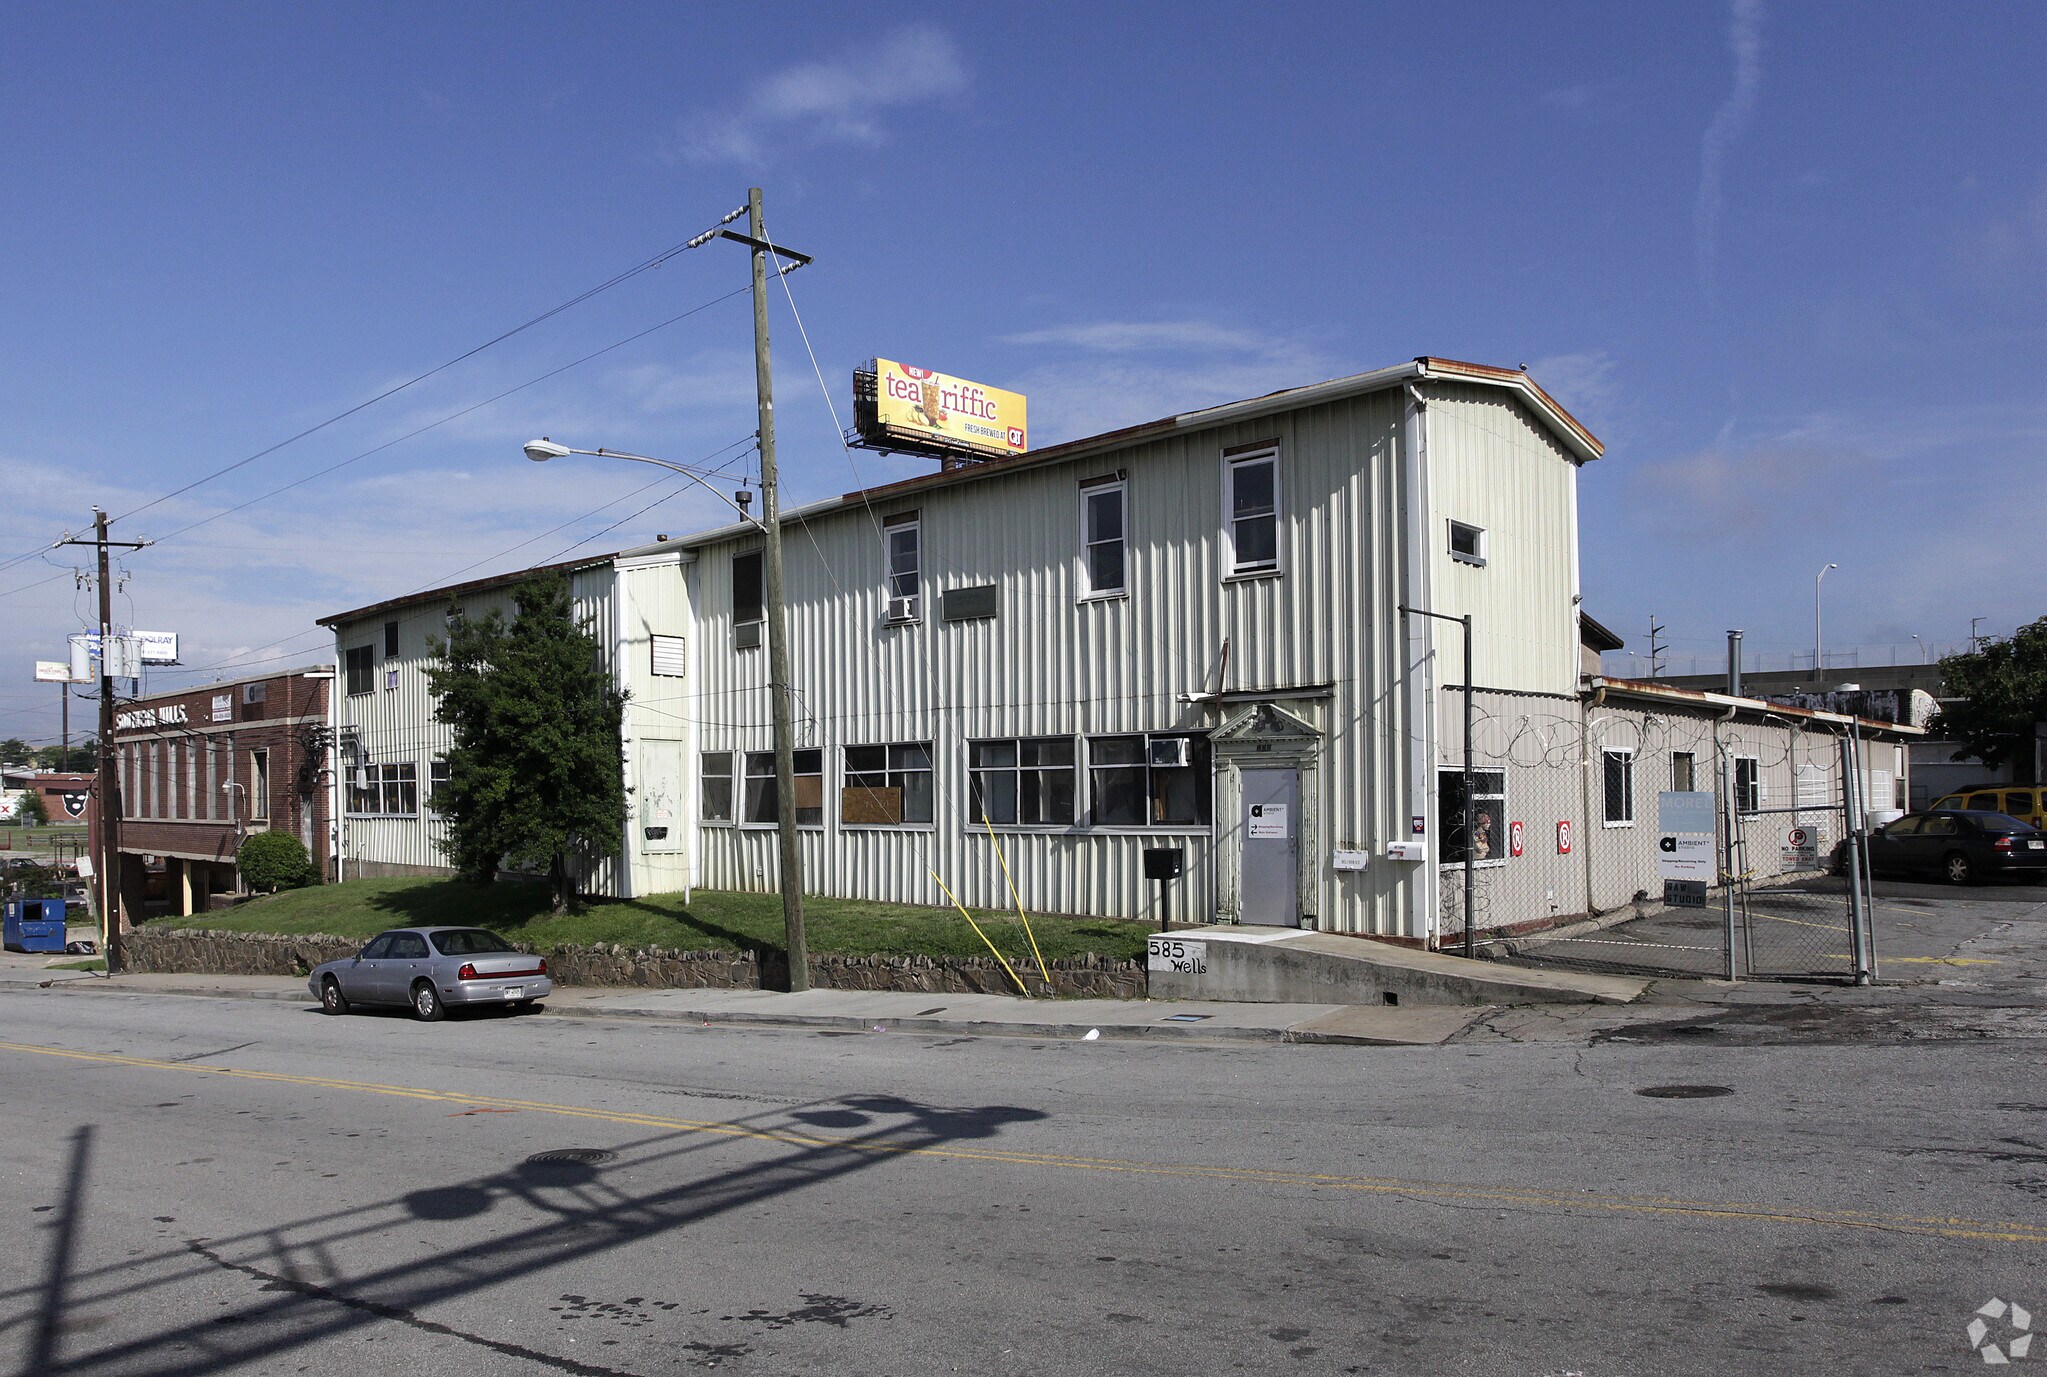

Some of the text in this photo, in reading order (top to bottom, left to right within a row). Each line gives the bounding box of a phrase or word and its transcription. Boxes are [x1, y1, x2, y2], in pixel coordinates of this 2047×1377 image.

[886, 371, 997, 421] tea riffic
[964, 423, 1006, 440] FRESH BREWED AT
[1008, 429, 1023, 446] QT
[1667, 894, 1702, 904] STUDIO
[1149, 941, 1185, 958] 585
[1170, 957, 1207, 974] Wells
